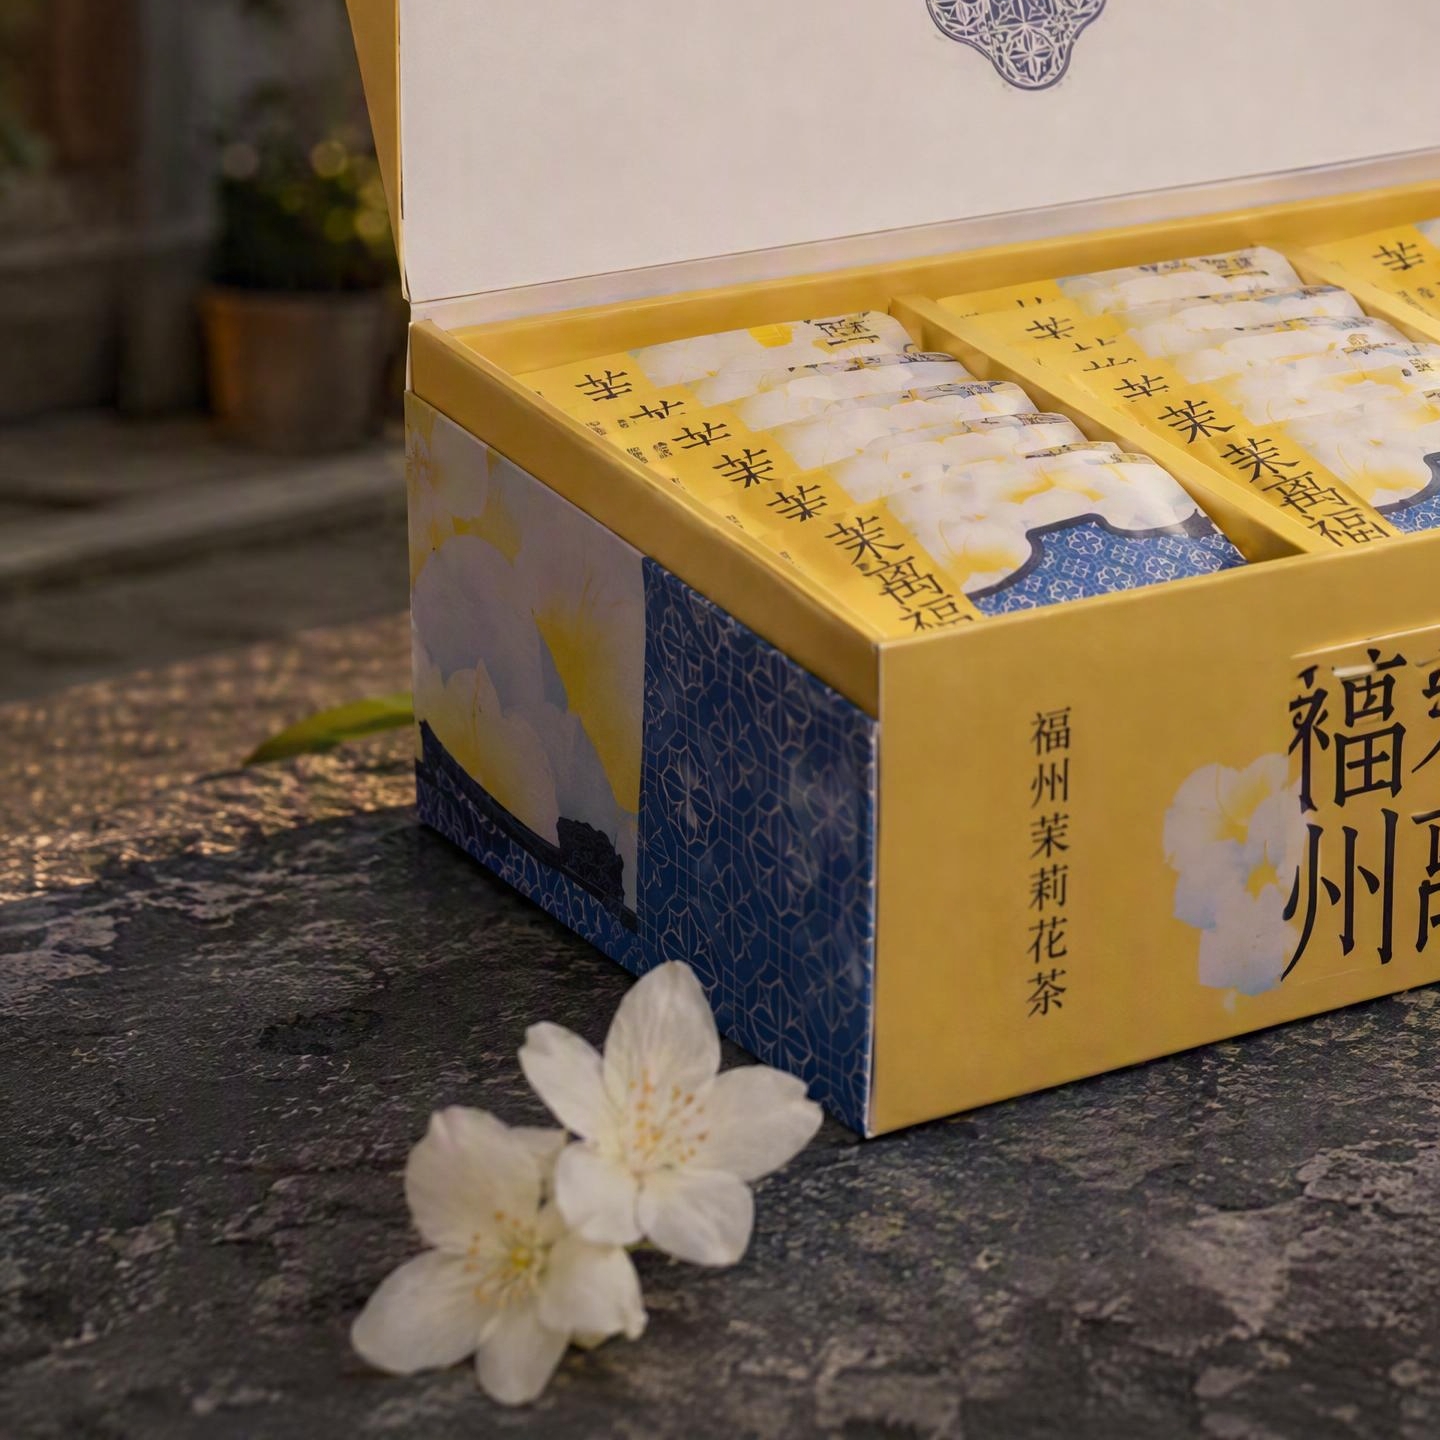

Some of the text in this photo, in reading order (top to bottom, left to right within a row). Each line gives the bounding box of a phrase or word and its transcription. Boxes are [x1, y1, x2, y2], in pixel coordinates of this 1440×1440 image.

[1026, 706, 1072, 1019] 福州茉莉花茶
